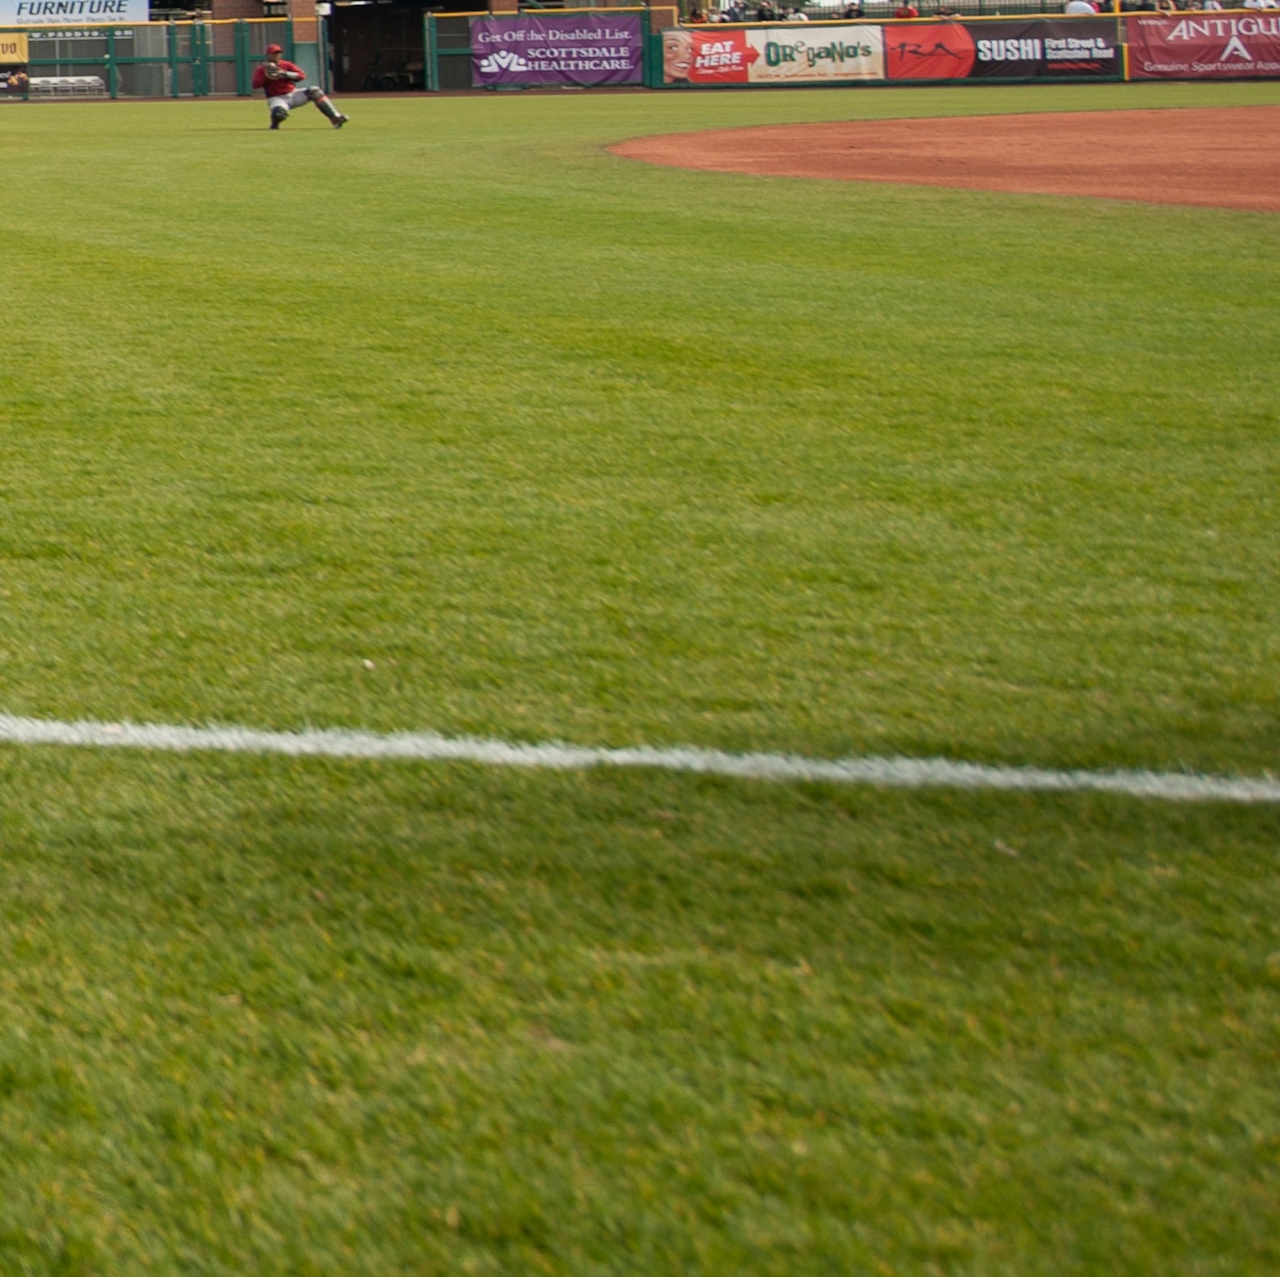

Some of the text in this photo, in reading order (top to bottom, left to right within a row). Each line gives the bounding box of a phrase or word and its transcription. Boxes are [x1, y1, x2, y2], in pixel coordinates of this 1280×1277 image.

[478, 28, 633, 43] Get Off the Disabled List.
[1167, 16, 1280, 41] ANTIGU
[526, 46, 630, 59] SCOTTSDALE
[700, 40, 735, 55] EAT
[977, 38, 1042, 61] SUSHI
[694, 52, 743, 68] HERE
[1143, 62, 1189, 72] Genuine
[1191, 61, 1255, 72] Sportswear
